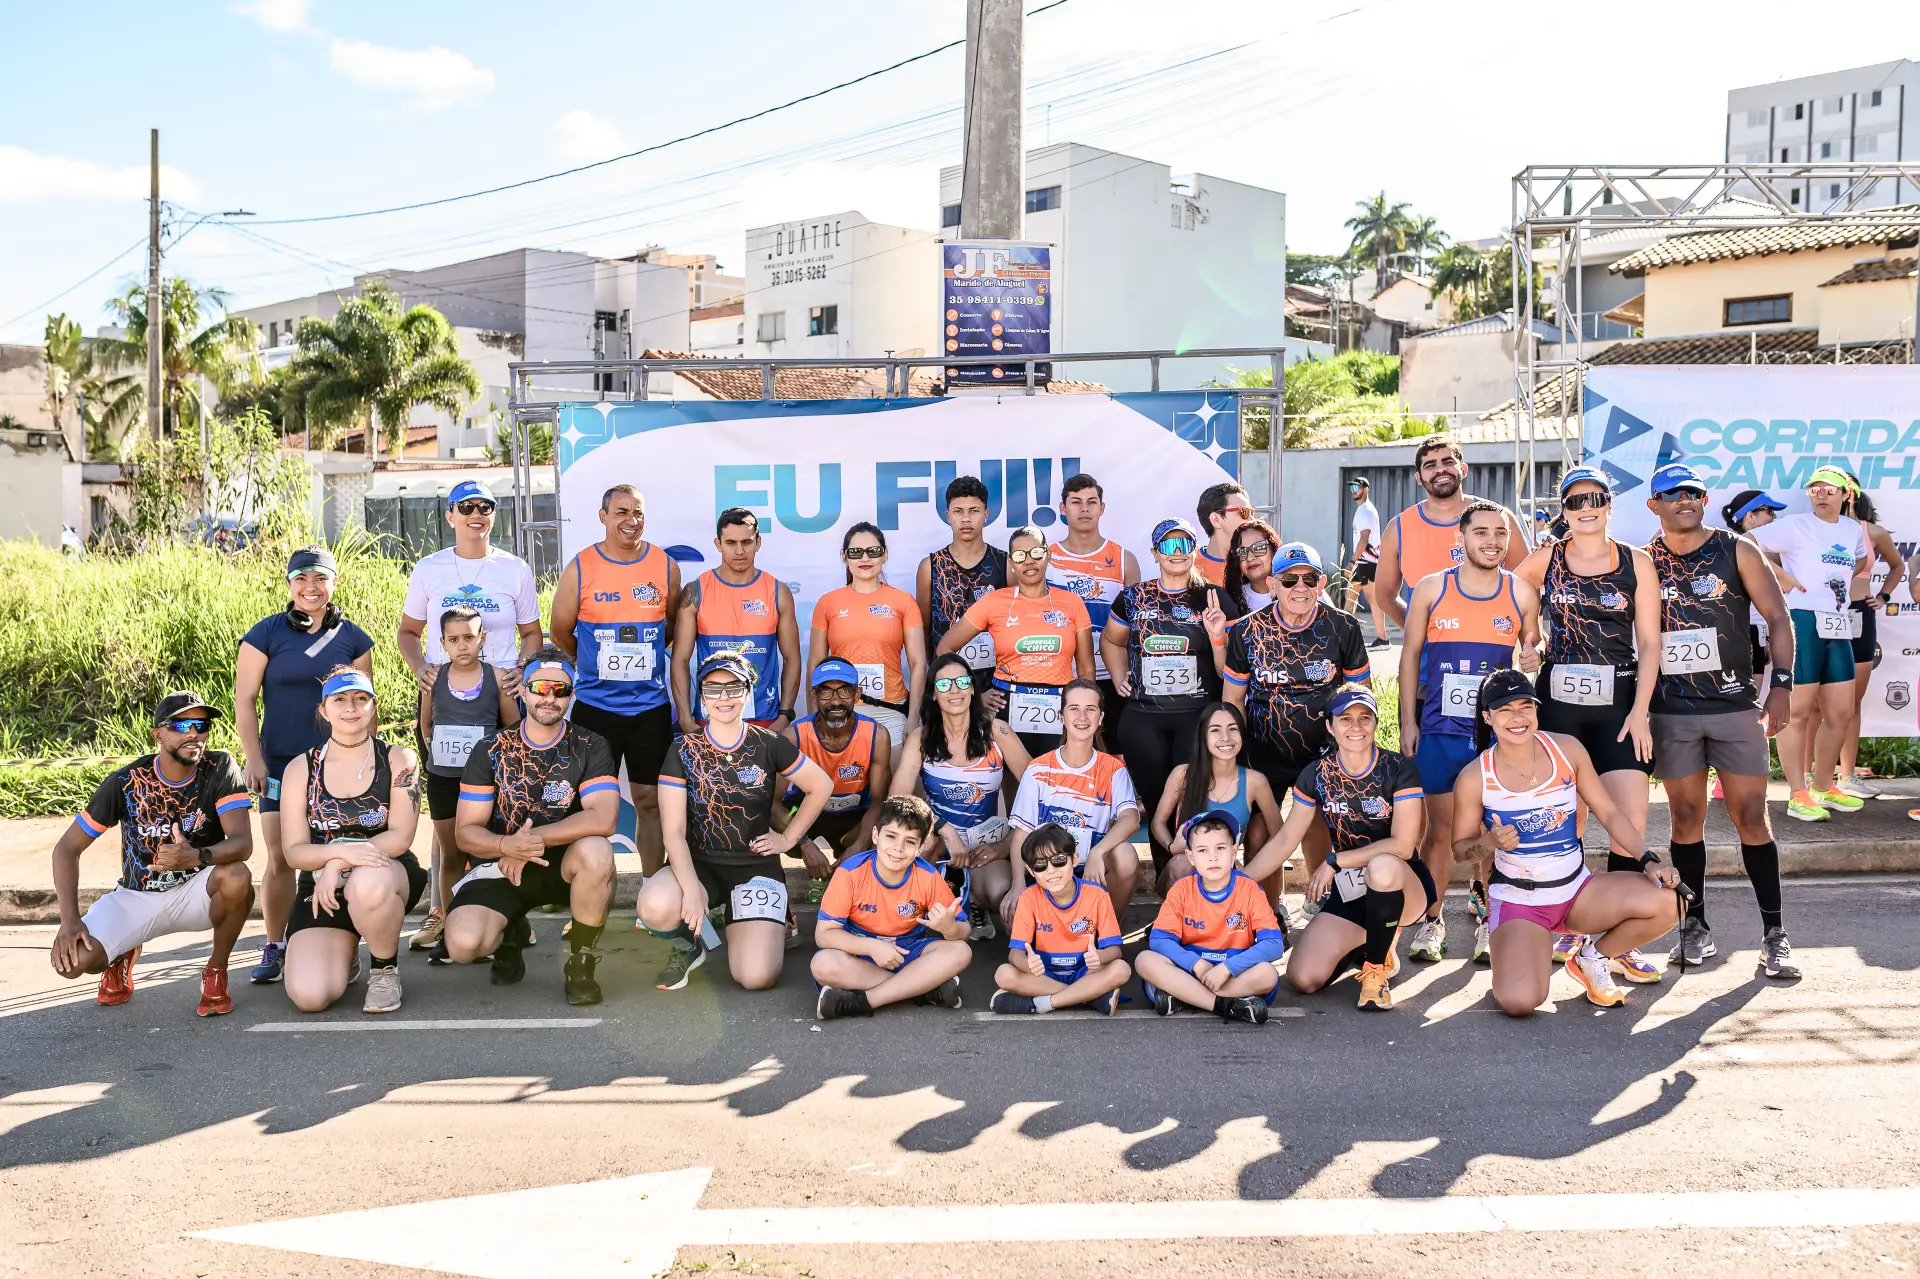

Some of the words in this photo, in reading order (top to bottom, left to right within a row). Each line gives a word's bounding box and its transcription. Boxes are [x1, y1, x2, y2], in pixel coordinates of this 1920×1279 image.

[953, 248, 1010, 278] JF
[954, 279, 981, 288] Marido
[984, 279, 995, 288] de
[996, 279, 1025, 289] Aluguel
[949, 296, 963, 304] 35
[967, 296, 1034, 305] 98411-0339
[1680, 419, 1920, 454] CORRIDA
[1683, 455, 1920, 490] CAMNH
[714, 463, 843, 534] EU
[876, 457, 1081, 531] FUI!!
[1825, 617, 1847, 631] 521
[957, 644, 990, 660] 05
[1667, 643, 1711, 663] 320
[608, 655, 647, 671] 874
[1151, 669, 1190, 685] 533
[1563, 677, 1602, 695] 551
[1017, 706, 1056, 723] 720
[439, 741, 473, 754] 1156
[977, 823, 1005, 845] 337
[740, 889, 781, 909] 392
